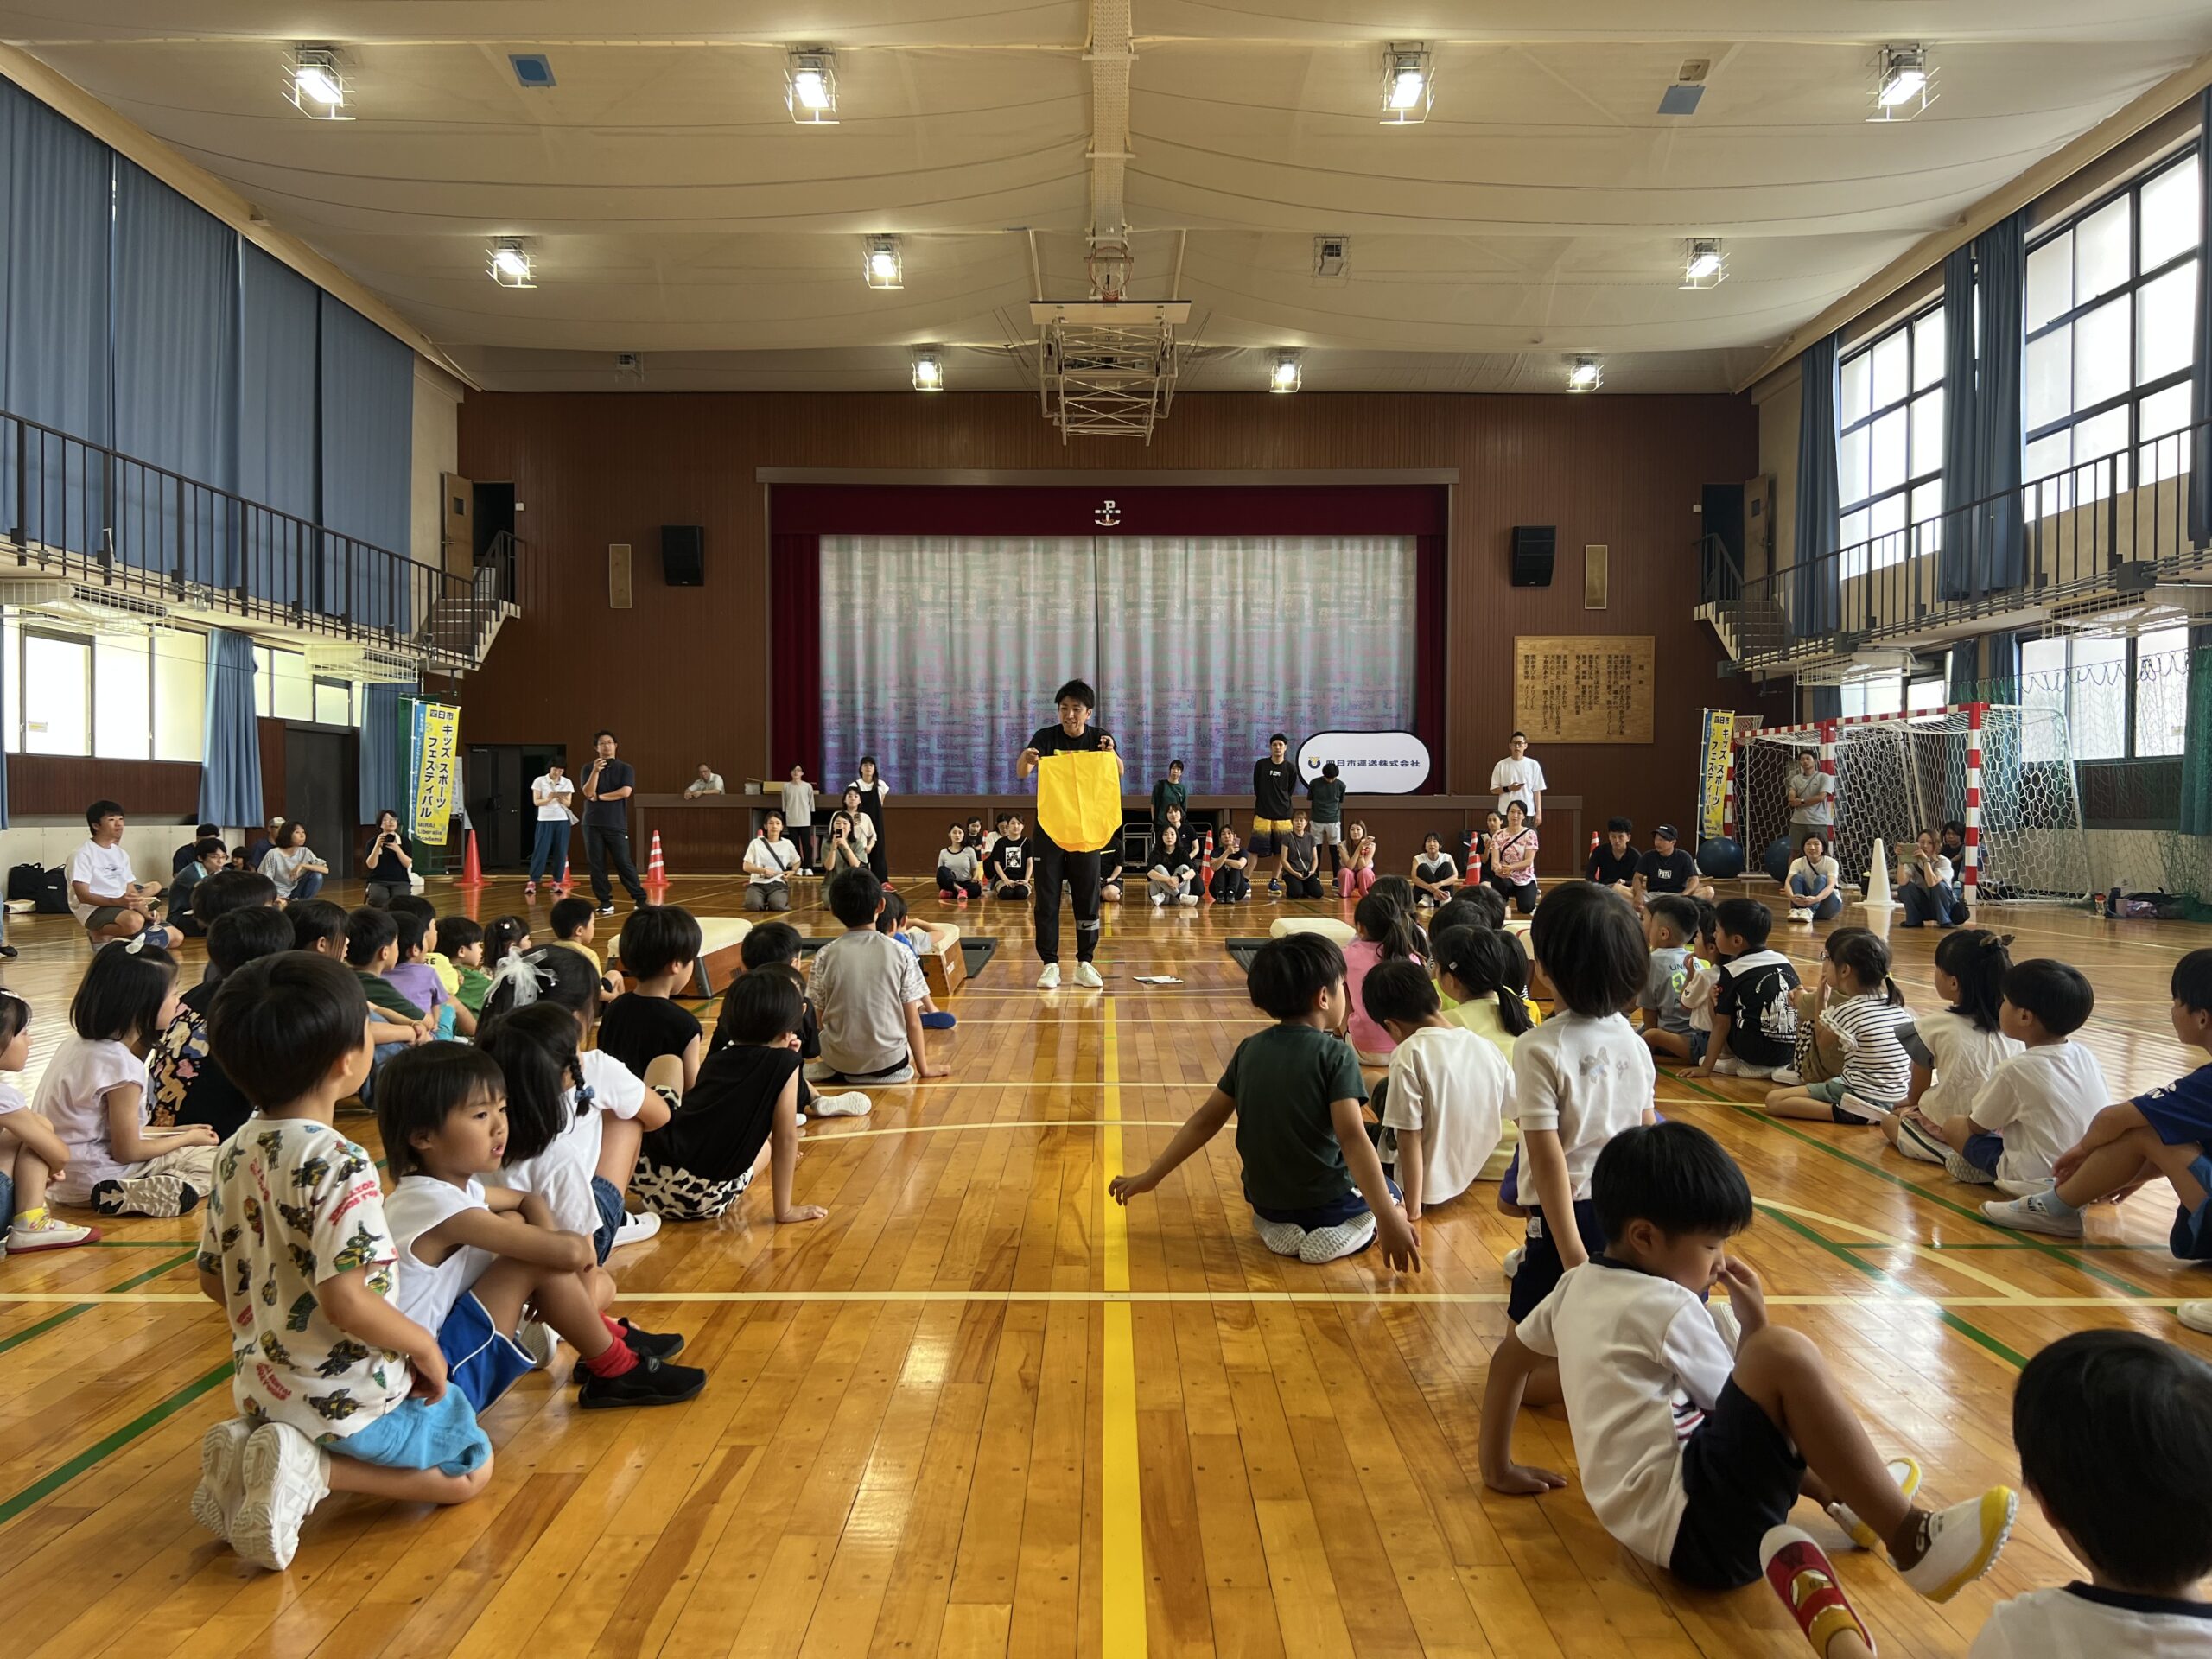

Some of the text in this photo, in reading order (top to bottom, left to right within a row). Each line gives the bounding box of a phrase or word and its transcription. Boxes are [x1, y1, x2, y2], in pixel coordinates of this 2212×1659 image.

[429, 709, 454, 721] 四日市
[1713, 715, 1730, 725] 四日市
[420, 737, 437, 817] フェスティバル
[436, 724, 453, 808] キッズ スポーツ
[1713, 728, 1729, 806] キッズ スポーツ
